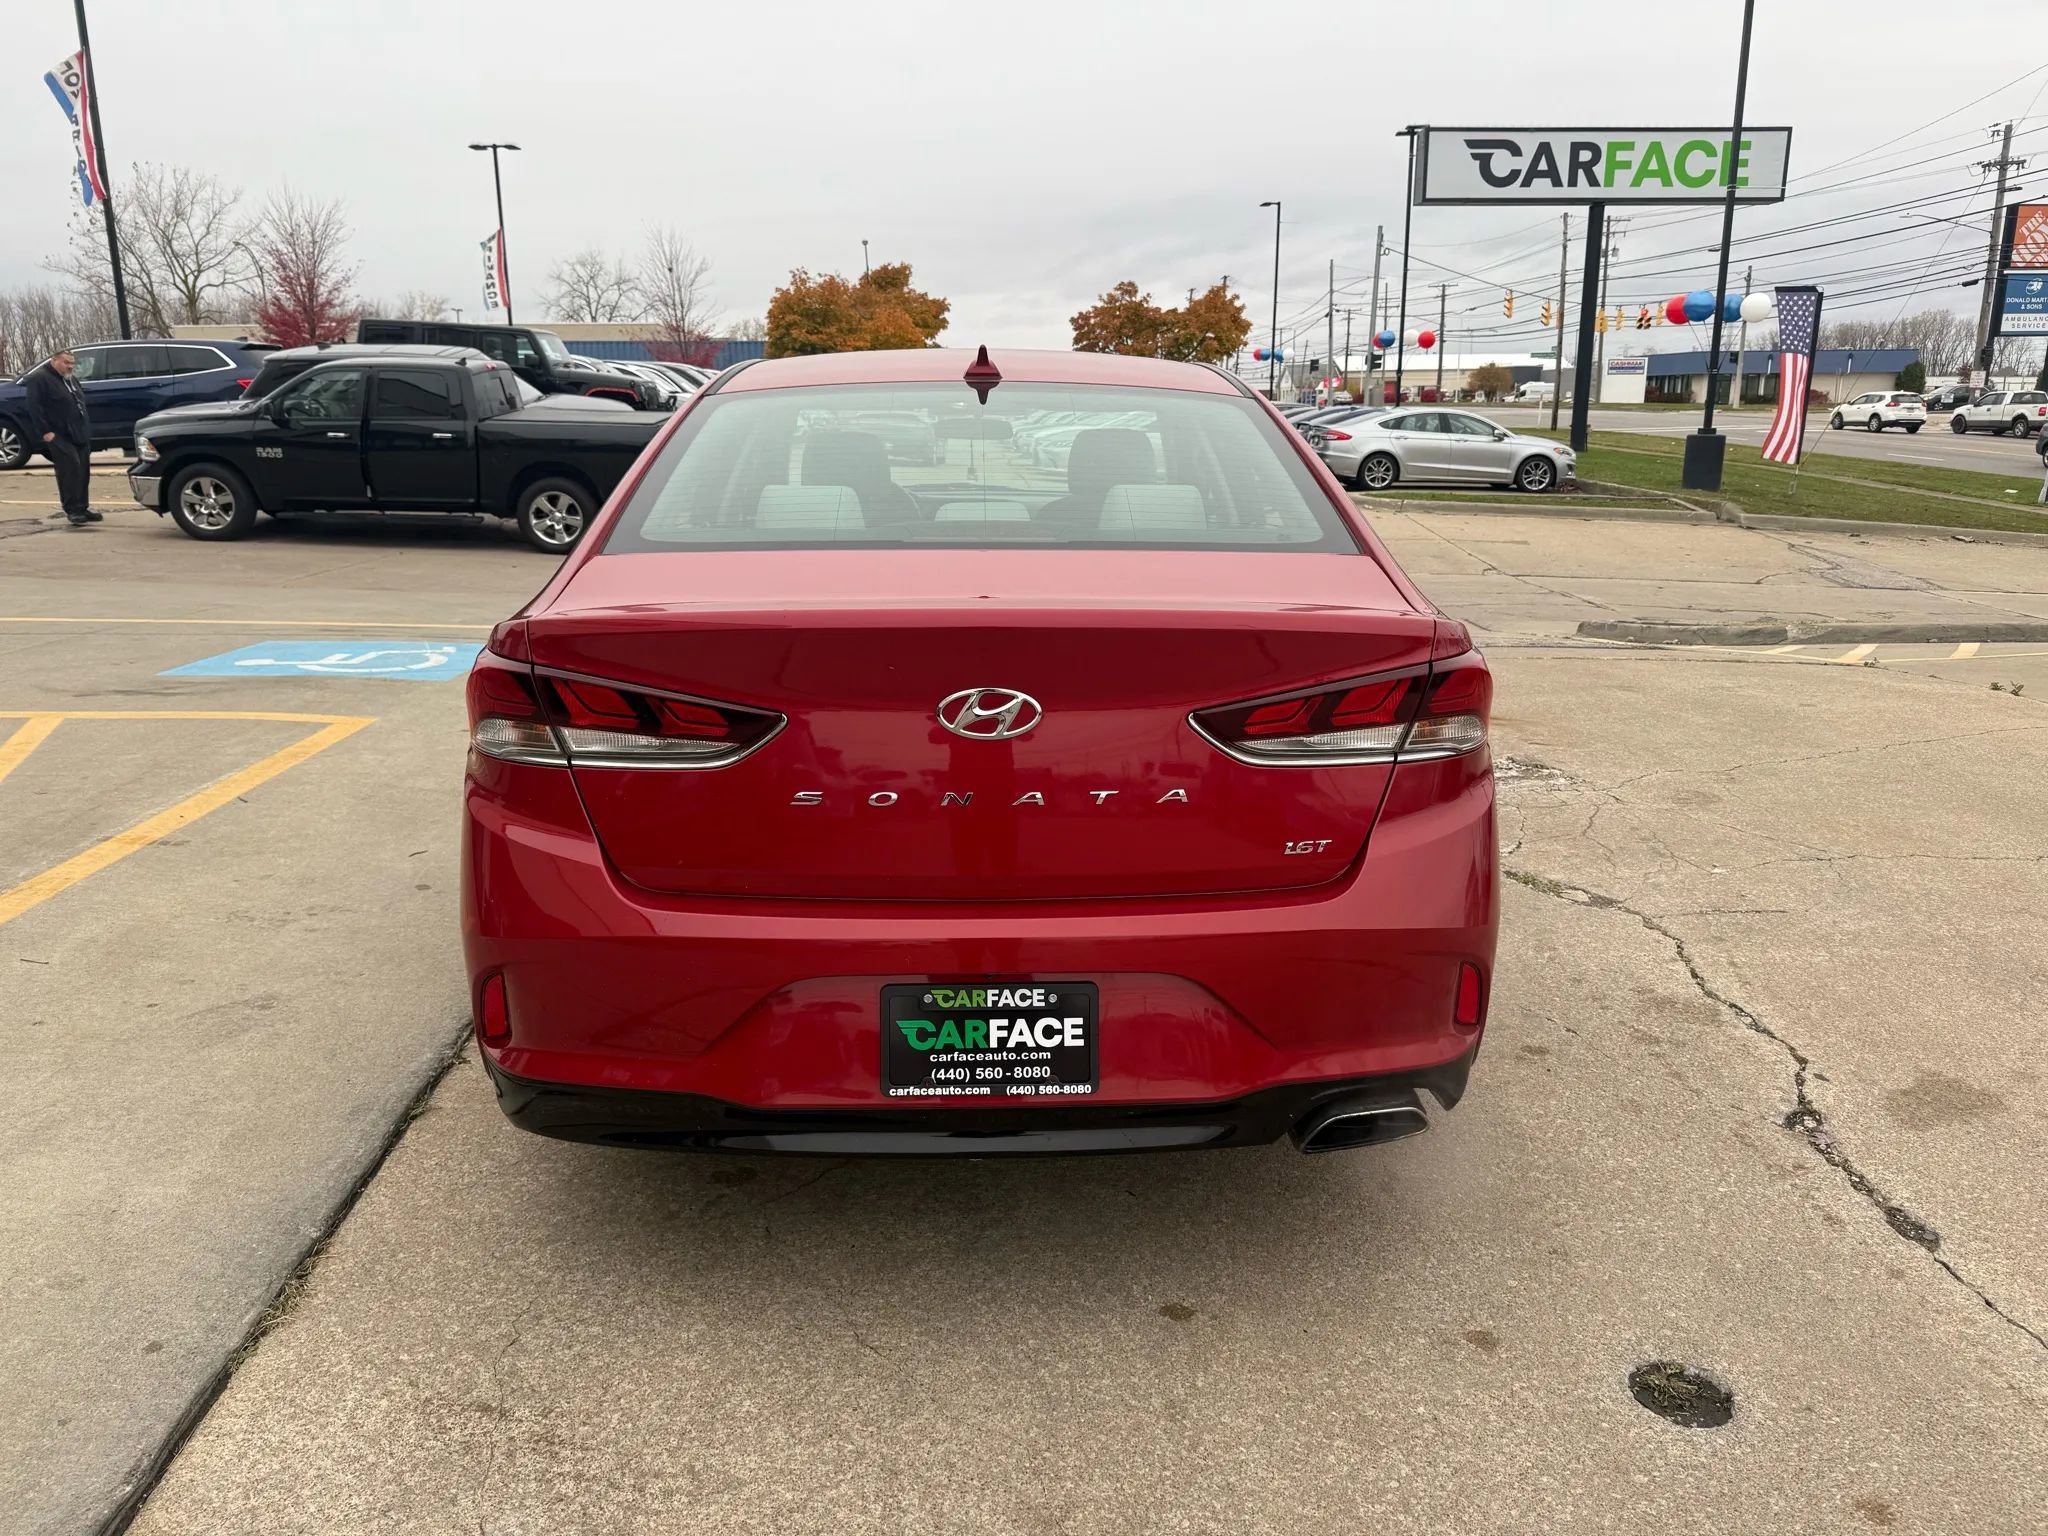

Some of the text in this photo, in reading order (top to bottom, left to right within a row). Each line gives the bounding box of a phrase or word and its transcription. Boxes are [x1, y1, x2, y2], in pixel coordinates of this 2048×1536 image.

[1463, 138, 1752, 188] CARFACE
[790, 788, 1188, 806] SONATA
[931, 989, 1046, 1008] CARFACE
[896, 1017, 1085, 1050] CARFACE
[929, 1051, 1052, 1062] carfaceauto.com
[931, 1067, 970, 1083] (440)
[889, 1085, 1092, 1096] carfaceauto.com (440) 560-8080
